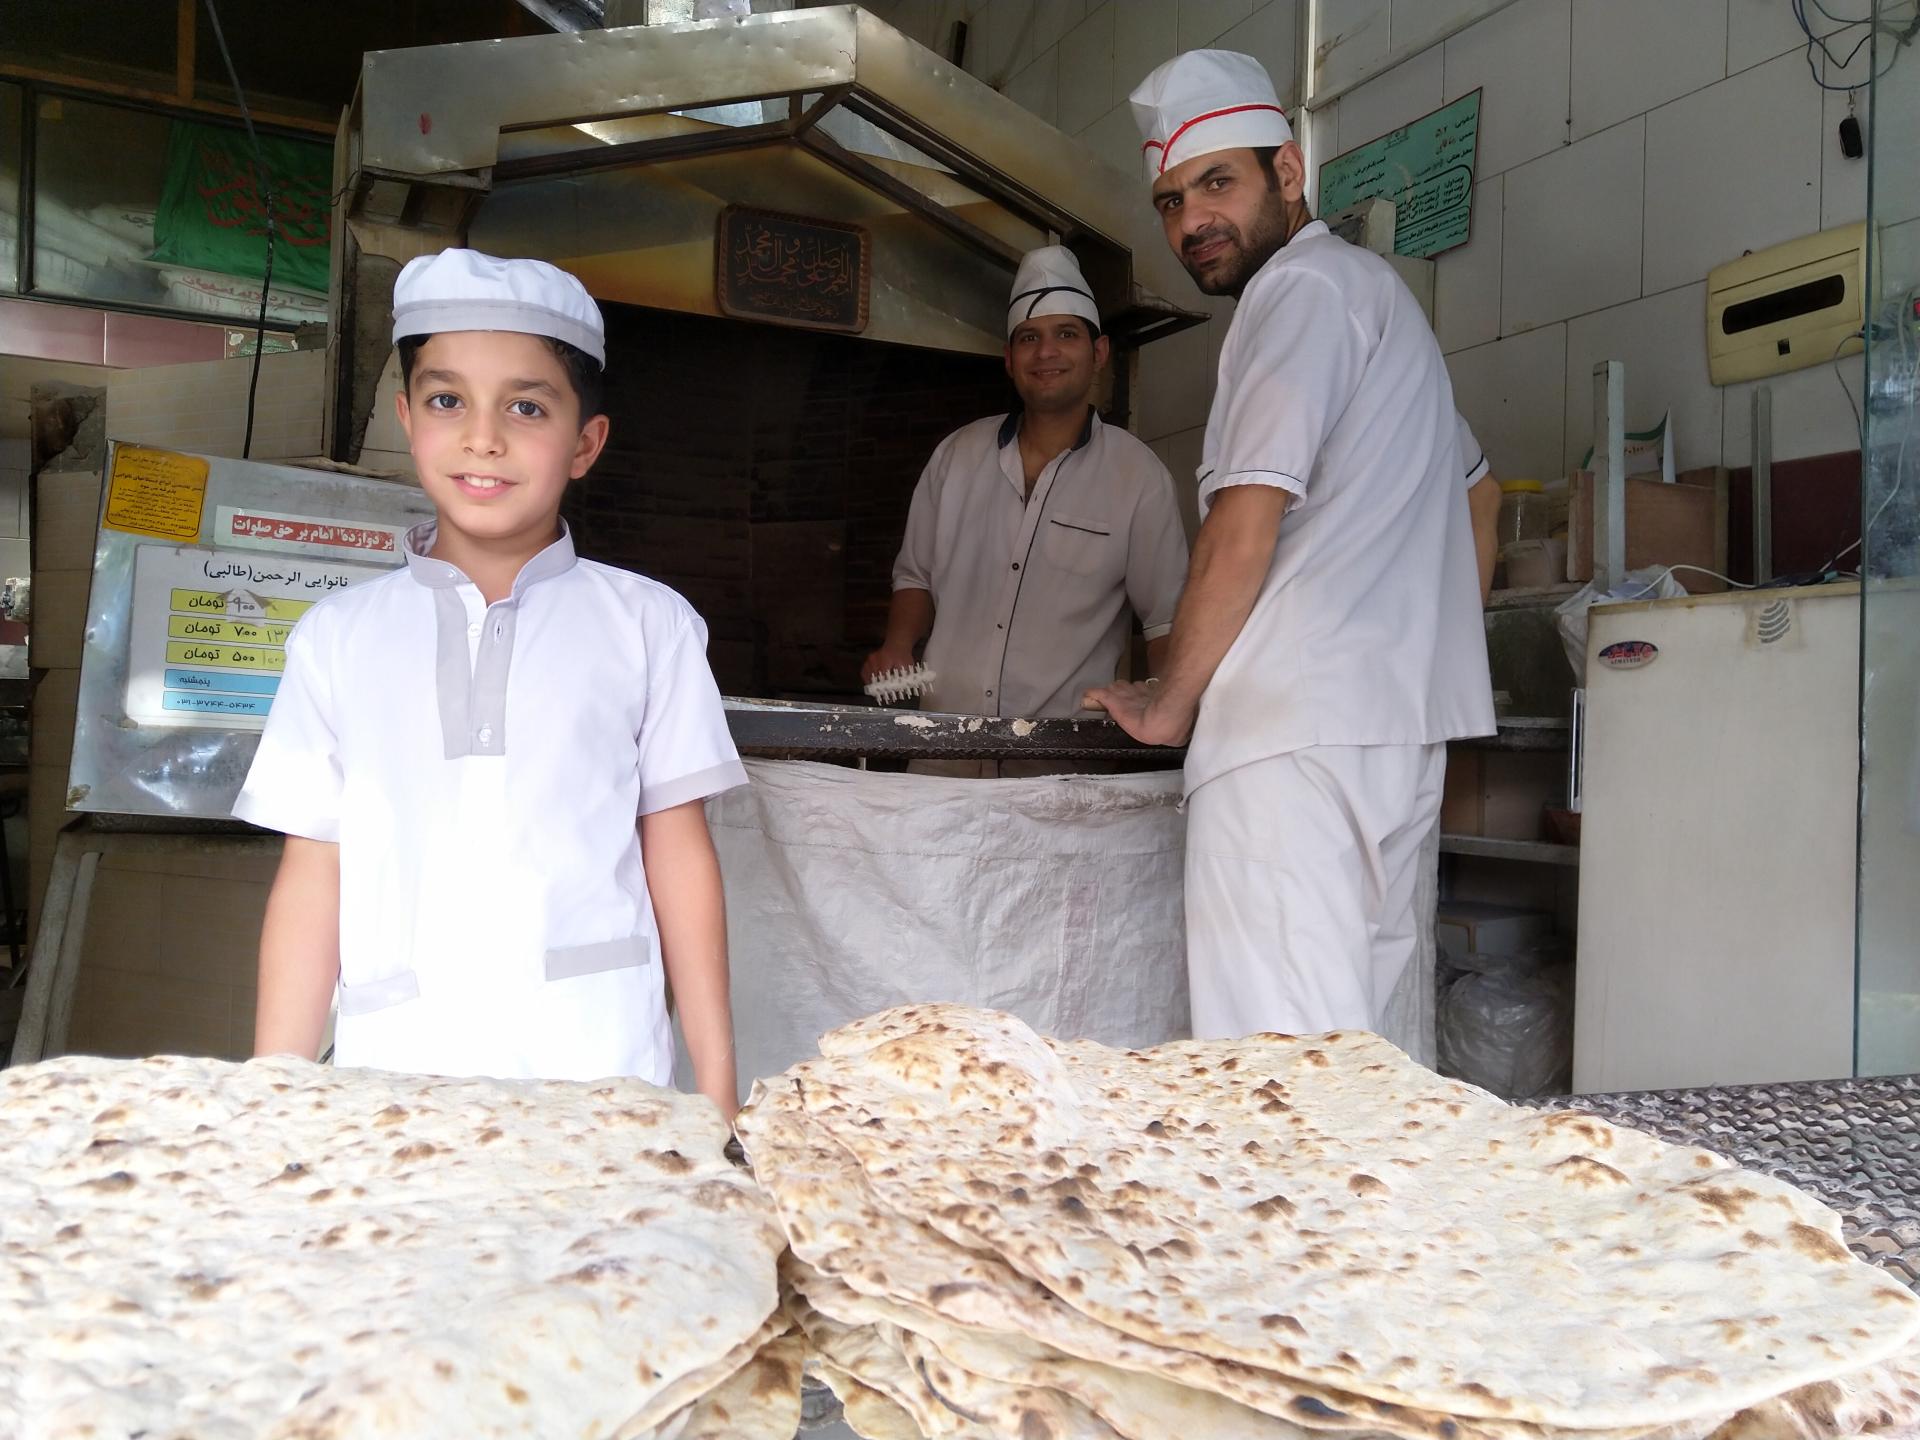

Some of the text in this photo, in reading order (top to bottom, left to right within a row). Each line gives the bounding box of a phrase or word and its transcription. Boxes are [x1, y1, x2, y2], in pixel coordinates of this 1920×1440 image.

[233, 517, 272, 536] صلوات
[273, 523, 294, 539] حق
[297, 526, 309, 541] بر
[310, 526, 334, 543] امام
[341, 532, 379, 549] دوازده
[381, 535, 393, 550] بر
[304, 573, 348, 590] نانوایی
[188, 595, 225, 610] تومان
[184, 621, 257, 637] ۷۰۰ تومان
[183, 647, 255, 663] ۵۰۰ تومان
